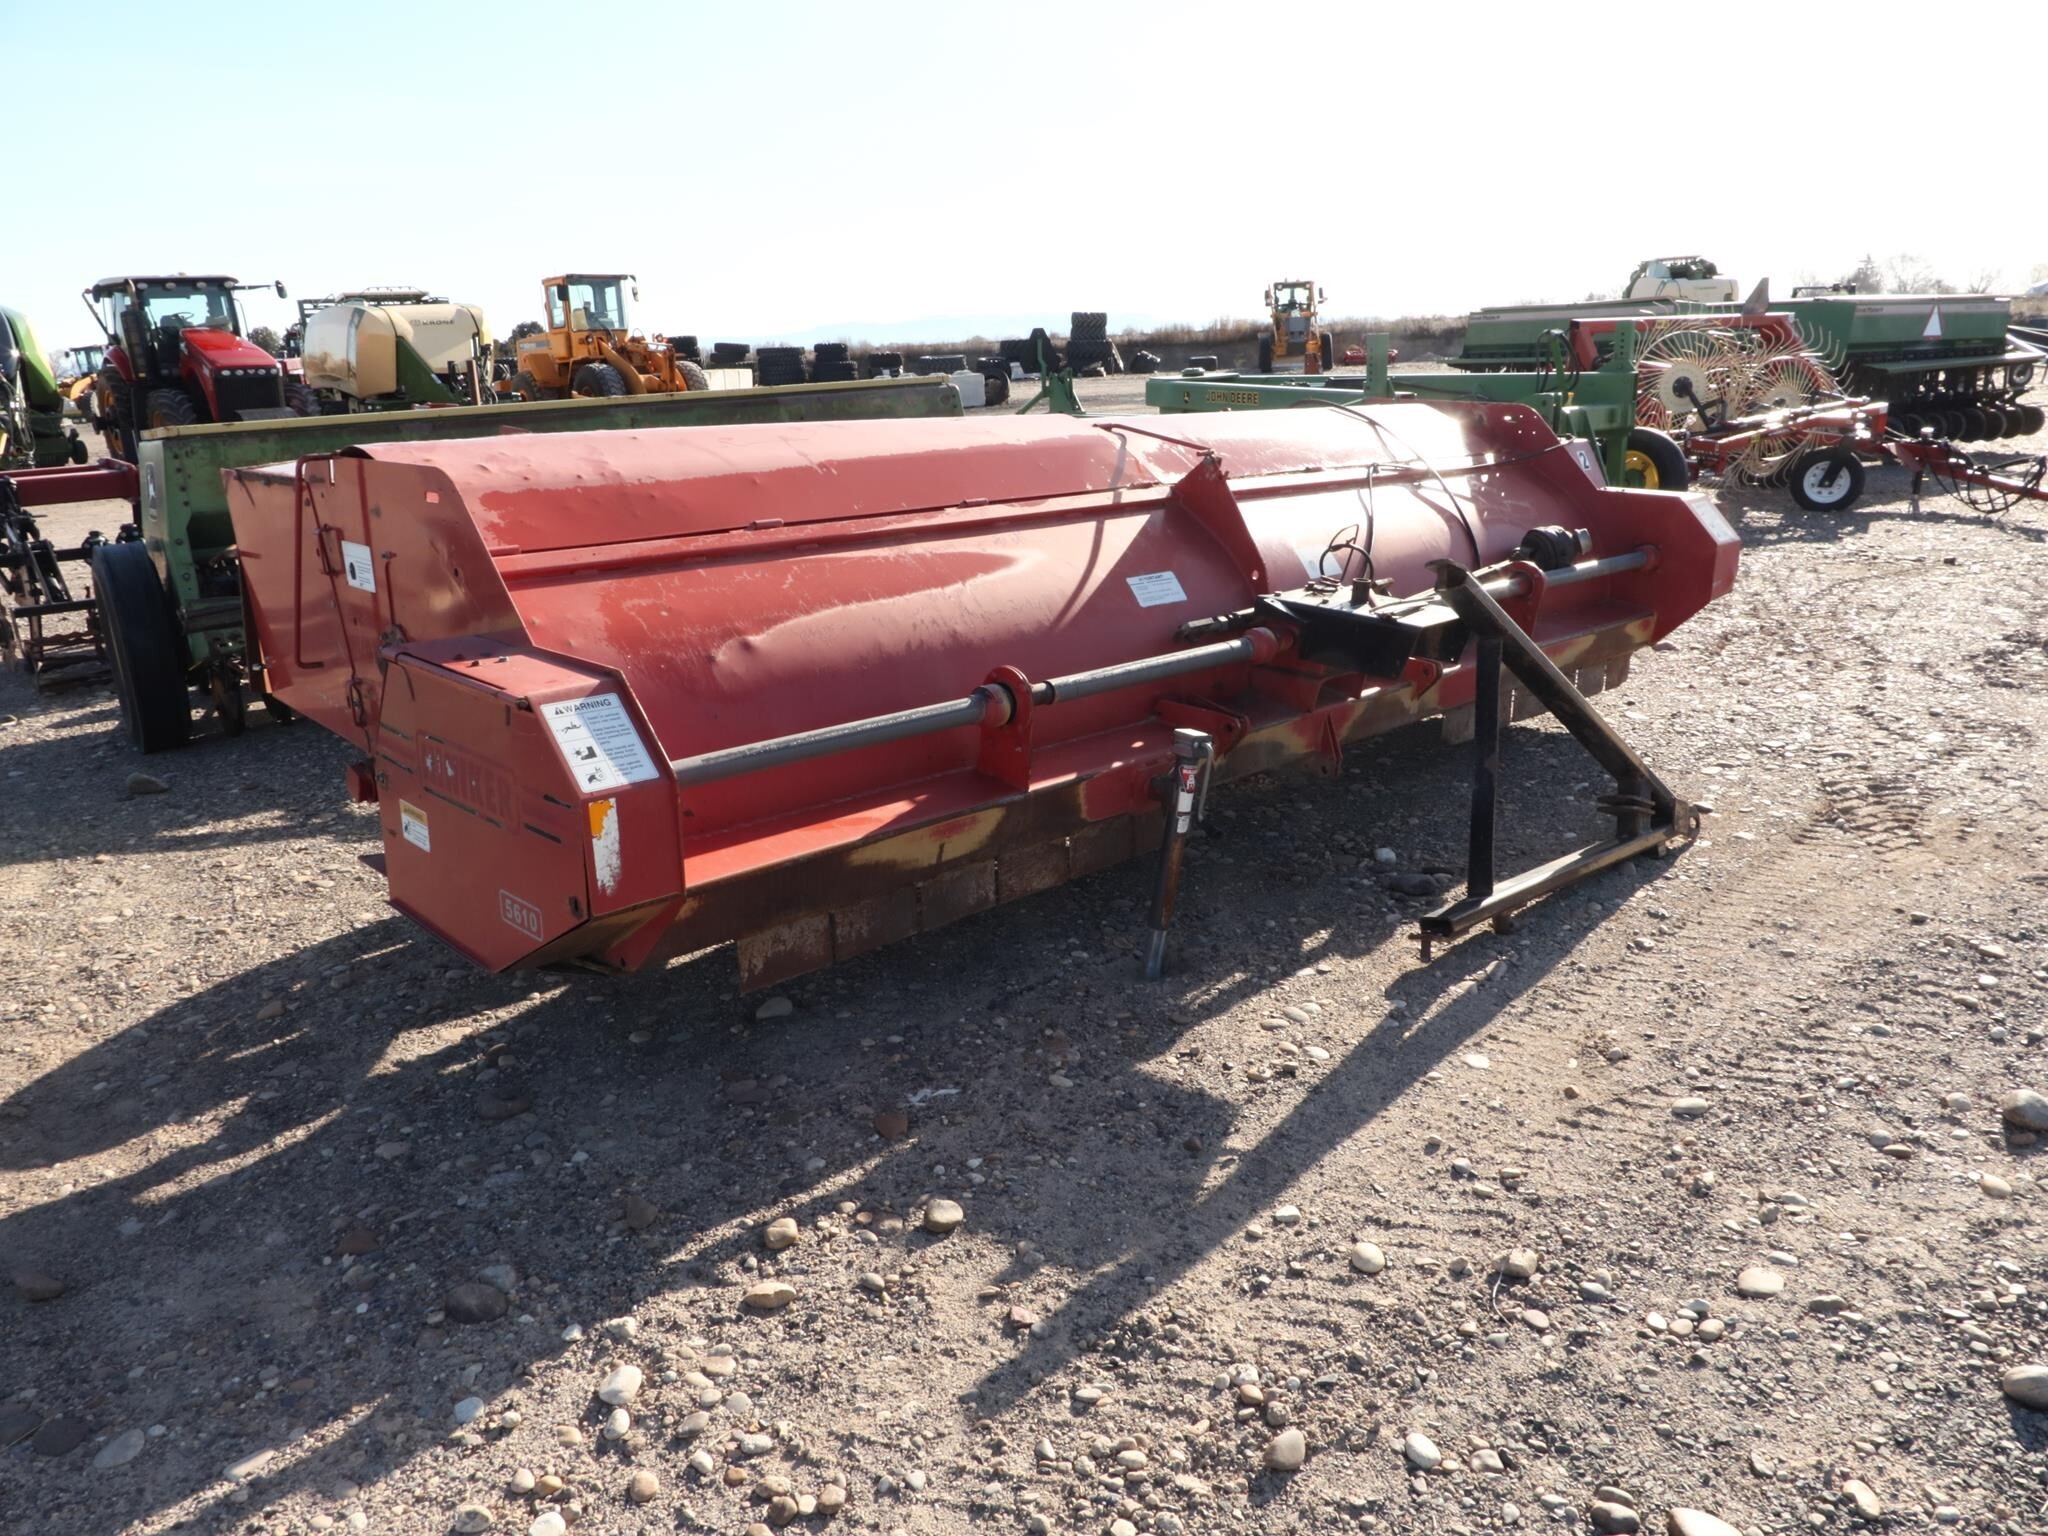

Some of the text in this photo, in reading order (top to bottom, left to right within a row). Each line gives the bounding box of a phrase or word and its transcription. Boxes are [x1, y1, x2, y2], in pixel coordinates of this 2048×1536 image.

[1206, 390, 1259, 405] JOHN DEERE
[1578, 452, 1590, 470] 2
[566, 698, 612, 713] WARNING
[505, 898, 538, 932] 5610
